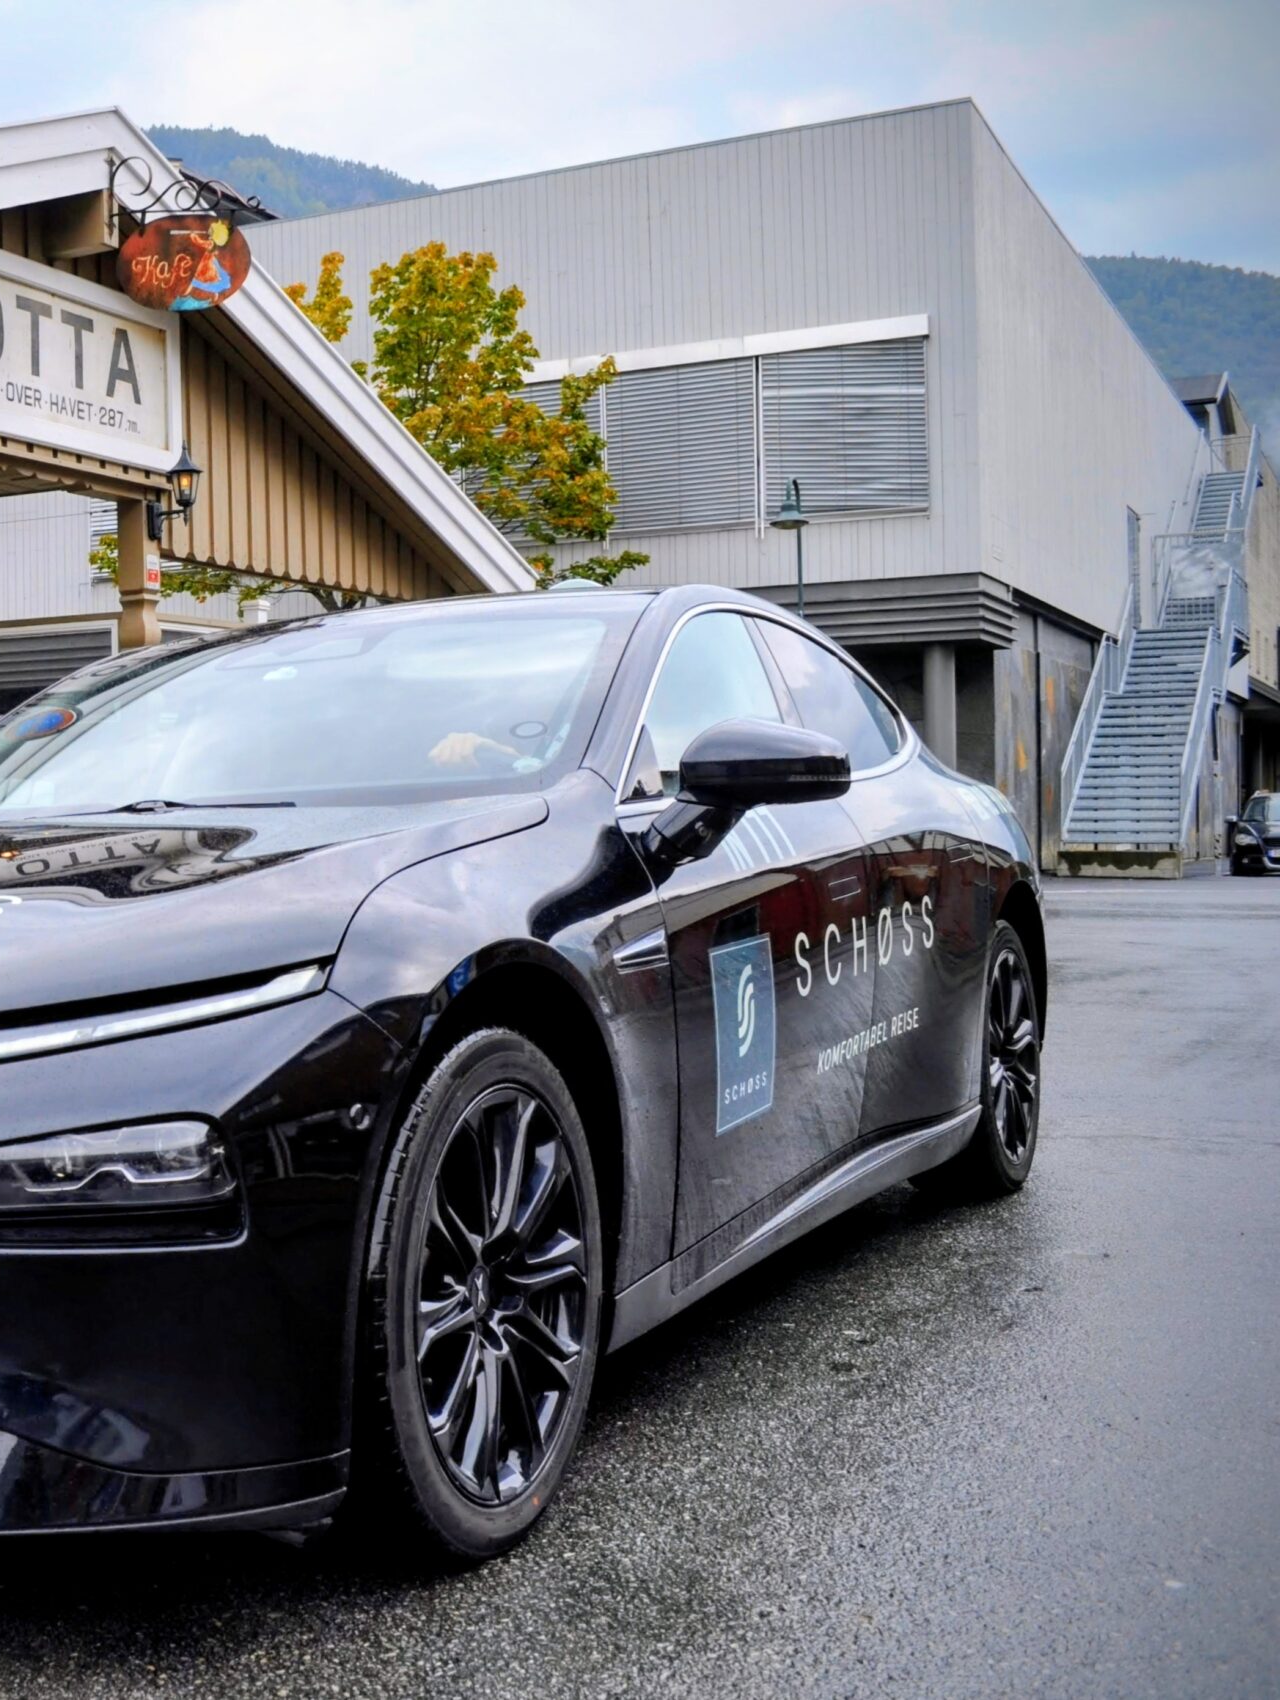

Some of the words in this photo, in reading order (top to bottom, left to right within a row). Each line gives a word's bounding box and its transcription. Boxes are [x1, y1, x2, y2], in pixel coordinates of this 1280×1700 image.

[794, 895, 935, 997] SCHØSS
[816, 1018, 888, 1075] KOMFORTABEL
[890, 1007, 920, 1038] REISE
[724, 1071, 767, 1105] SCHØSS
